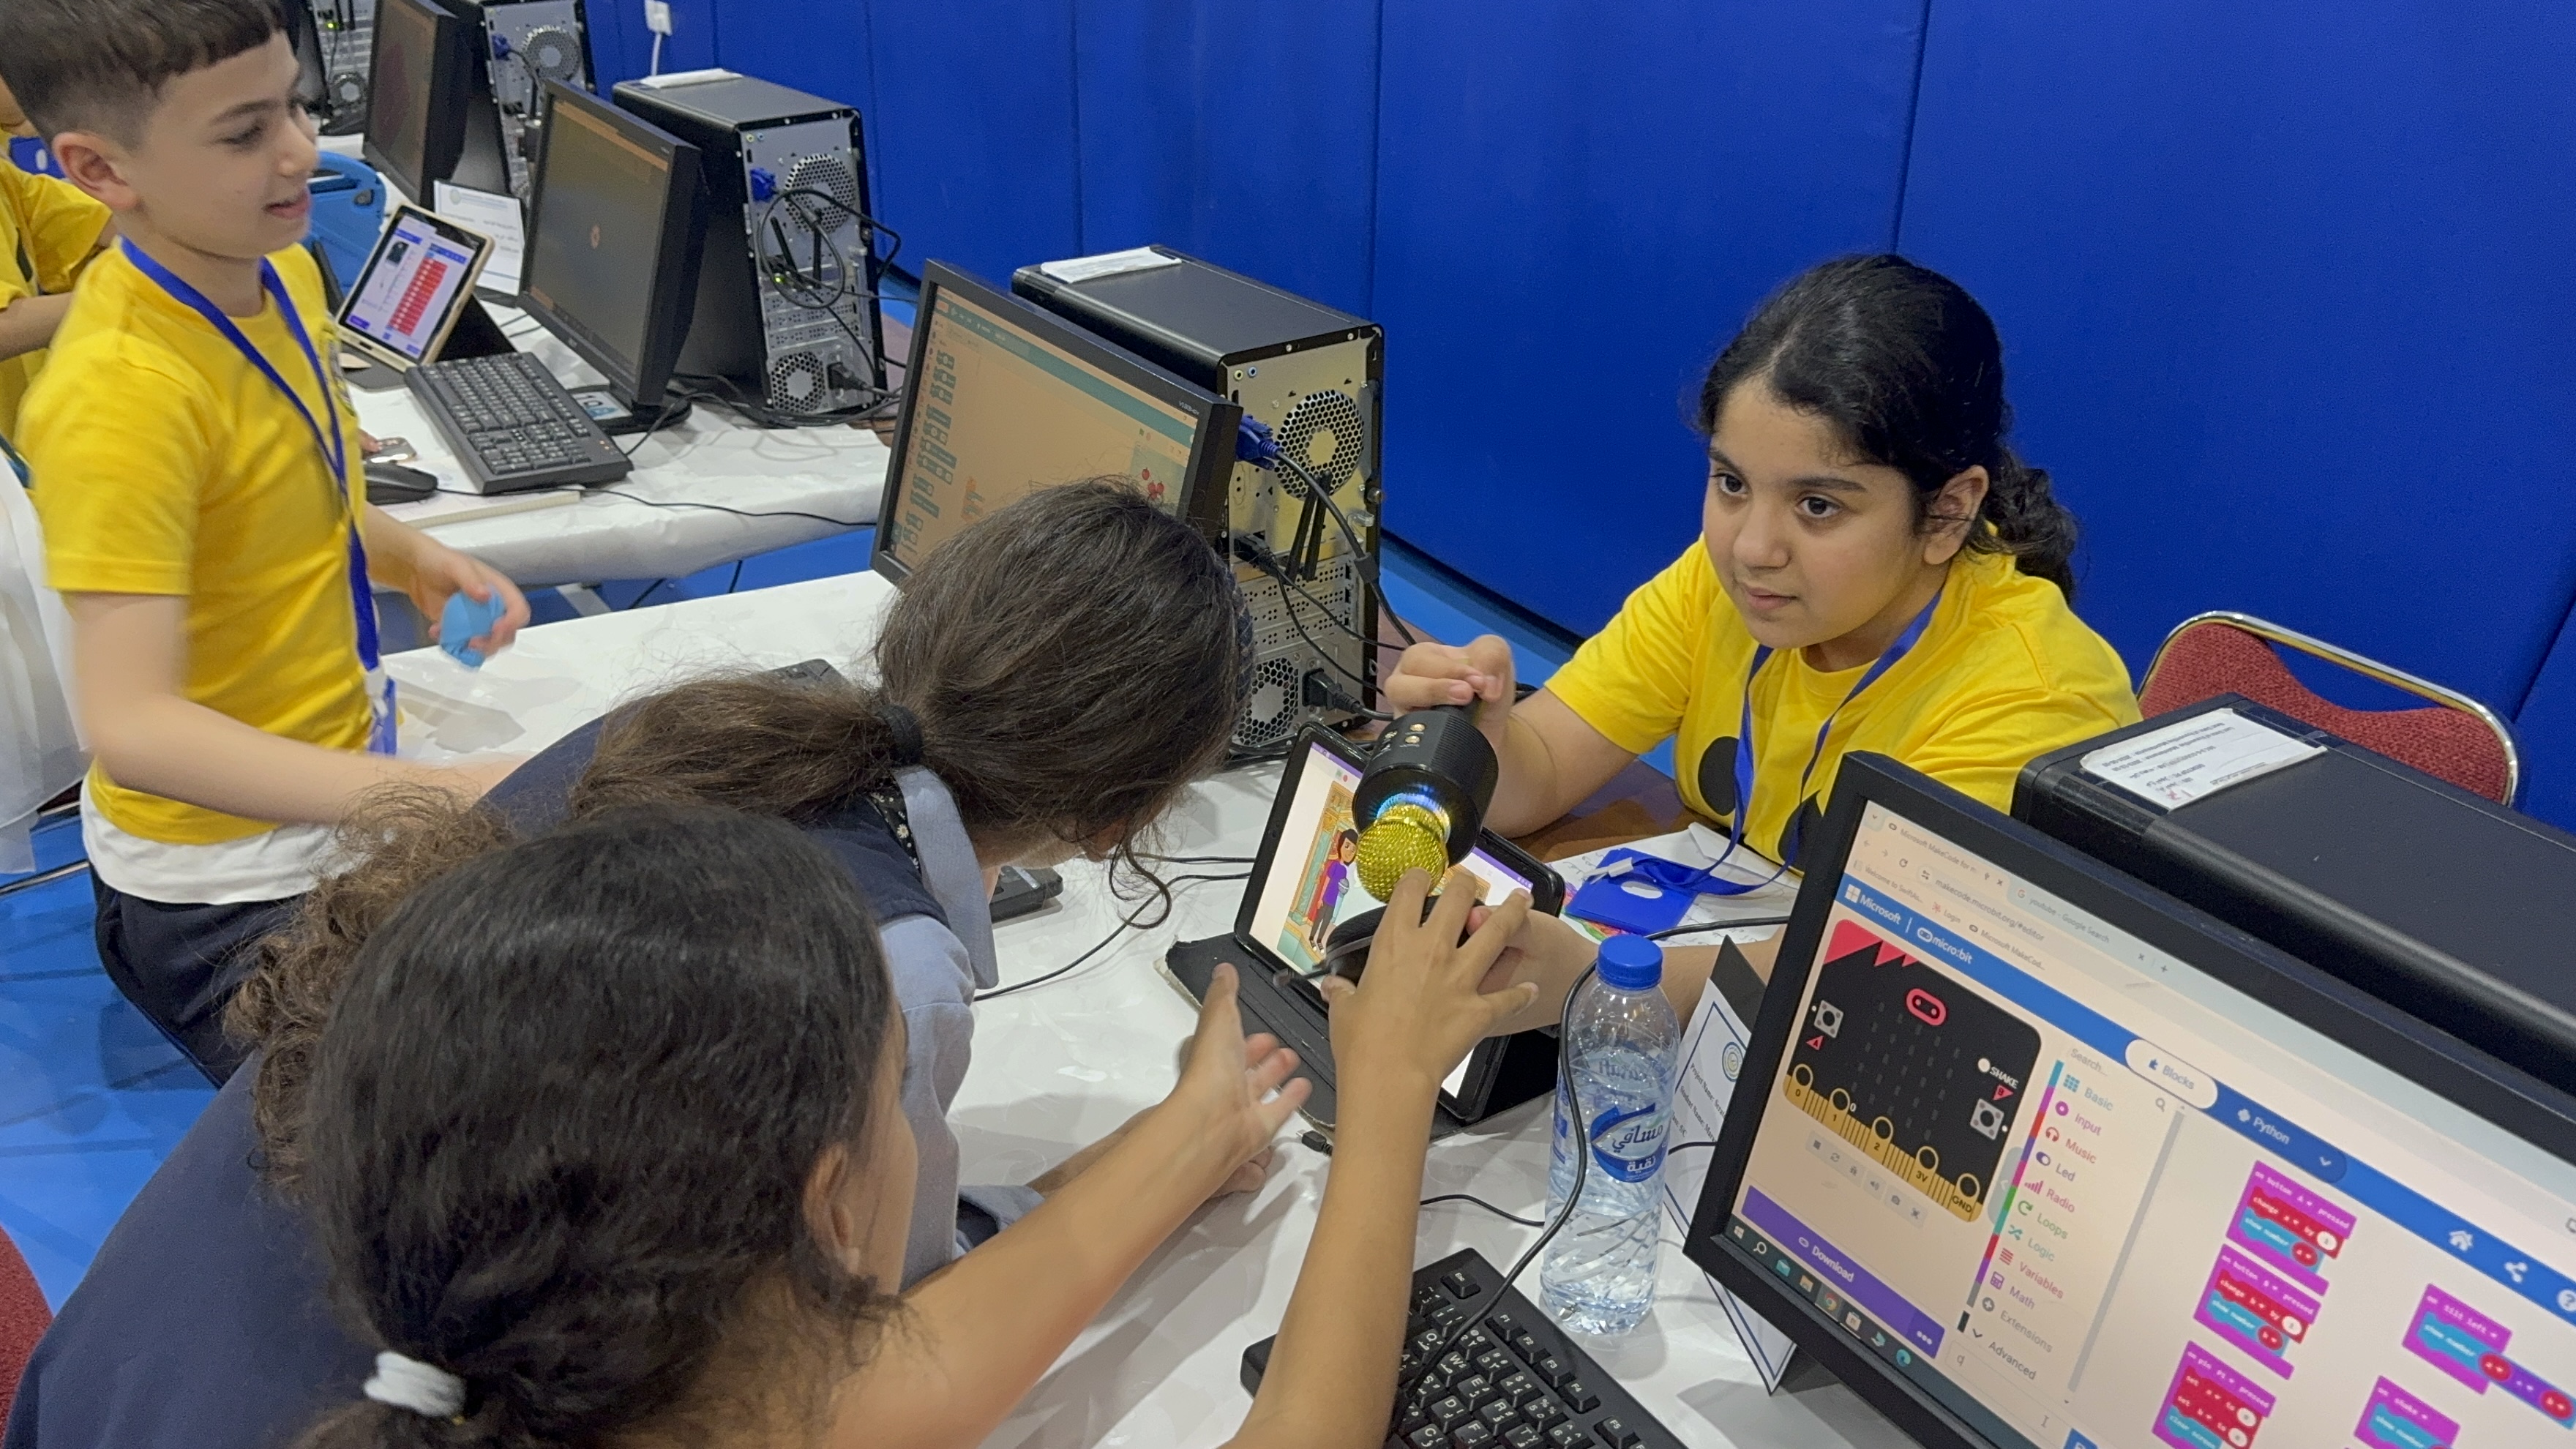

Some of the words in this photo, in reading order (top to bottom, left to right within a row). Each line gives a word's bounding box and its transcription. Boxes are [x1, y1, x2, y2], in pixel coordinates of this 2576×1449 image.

[1901, 828, 1928, 847] Microsoft
[1928, 843, 1959, 865] MakeCode
[1961, 860, 1969, 872] for
[1860, 894, 1901, 925] Microsoft
[1944, 910, 1961, 924] Login
[2030, 898, 2056, 916] youtube
[2062, 913, 2086, 933] Google
[2087, 926, 2109, 943] Search
[1932, 935, 1973, 965] micro:bit
[1980, 929, 2011, 951] Microsoft
[1811, 1038, 1820, 1047] A
[1690, 1063, 1704, 1085] Project
[1702, 1080, 1715, 1102] Name:
[1990, 1066, 2019, 1089] SHAKE
[2163, 1065, 2195, 1090] Blocks
[1794, 1088, 1802, 1098] 0
[2083, 1087, 2113, 1112] Basic
[1680, 1085, 1693, 1109] Student
[1693, 1106, 1705, 1128] Name:
[2074, 1112, 2102, 1137] Input
[2253, 1116, 2291, 1145] Python
[1611, 1123, 1663, 1153] مسافي
[1873, 1142, 1881, 1152] 2
[2065, 1138, 2097, 1165] Music
[1626, 1156, 1655, 1174] نقية
[2055, 1163, 2076, 1183] Led
[1916, 1170, 1928, 1183] 3V
[1952, 1195, 1972, 1214] GND
[2046, 1188, 2075, 1213] Radio
[2037, 1213, 2069, 1240] Loops
[2028, 1238, 2056, 1262] Logic
[1811, 1245, 1855, 1284] Download
[2019, 1262, 2064, 1300] Variables
[2009, 1286, 2035, 1310] Math
[1426, 1333, 1437, 1341] Q
[1523, 1336, 1534, 1346] F2
[2000, 1310, 2053, 1353] Extensions
[1450, 1354, 1464, 1366] W
[1546, 1359, 1558, 1368] F3
[1988, 1341, 2037, 1380] Advanced
[1423, 1375, 1434, 1384] S
[1470, 1377, 1484, 1387] E
[1570, 1382, 1582, 1393] F4
[1445, 1399, 1457, 1407] D
[1494, 1401, 1508, 1412] R
[1425, 1428, 1437, 1437] C
[1467, 1423, 1481, 1431] F
[1520, 1426, 1532, 1435] T
[1609, 1419, 1622, 1430] F5
